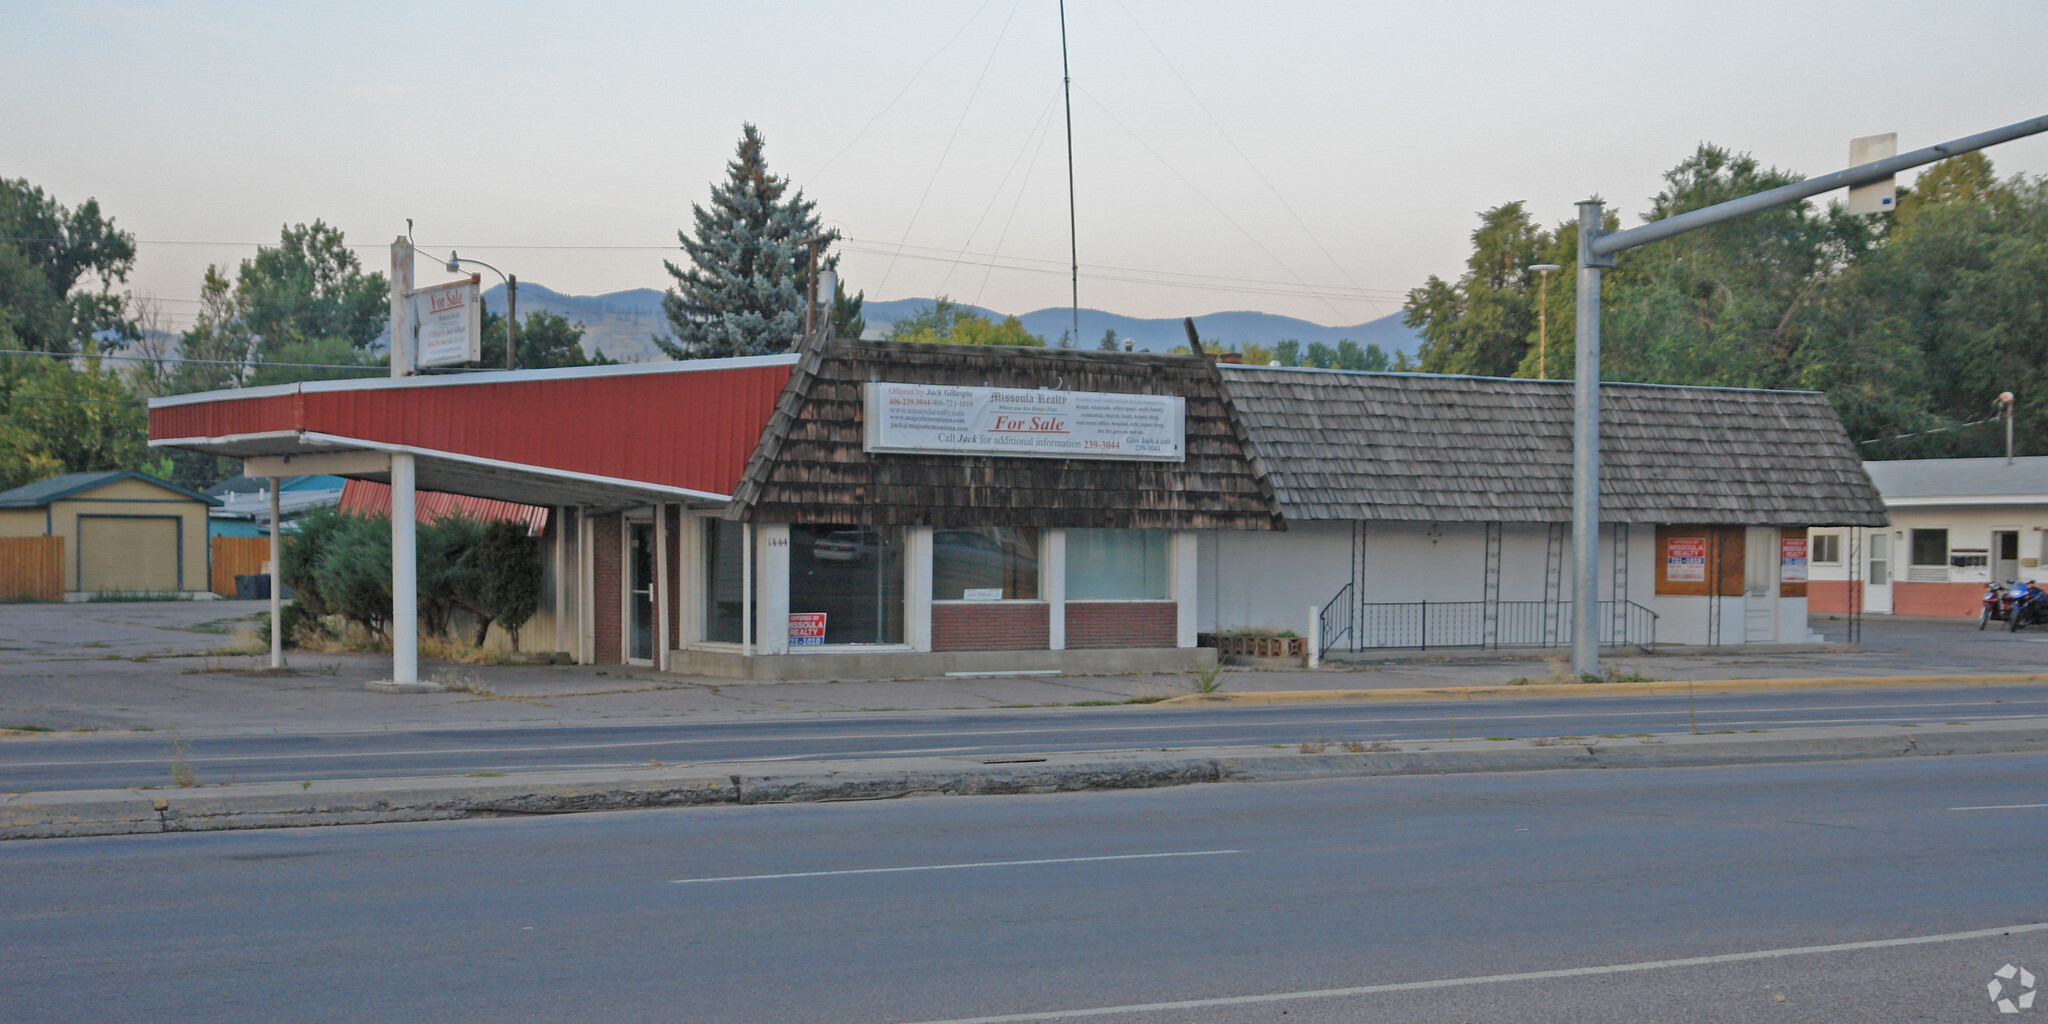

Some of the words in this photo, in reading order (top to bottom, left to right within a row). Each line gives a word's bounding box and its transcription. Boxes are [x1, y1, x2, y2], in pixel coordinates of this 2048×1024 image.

[430, 294, 445, 310] For
[446, 288, 462, 307] Sale
[916, 388, 924, 396] by
[944, 390, 973, 398] Gillespie
[990, 392, 1034, 403] Missoula
[1036, 394, 1067, 404] Realty
[995, 416, 1025, 430] For
[1030, 416, 1064, 430] Sale
[938, 432, 955, 442] Call
[957, 434, 977, 443] Jack
[979, 435, 992, 444] for
[994, 436, 1034, 446] additional
[1036, 438, 1082, 448] information
[1084, 440, 1120, 449] 239-3044
[768, 538, 788, 547] 1444
